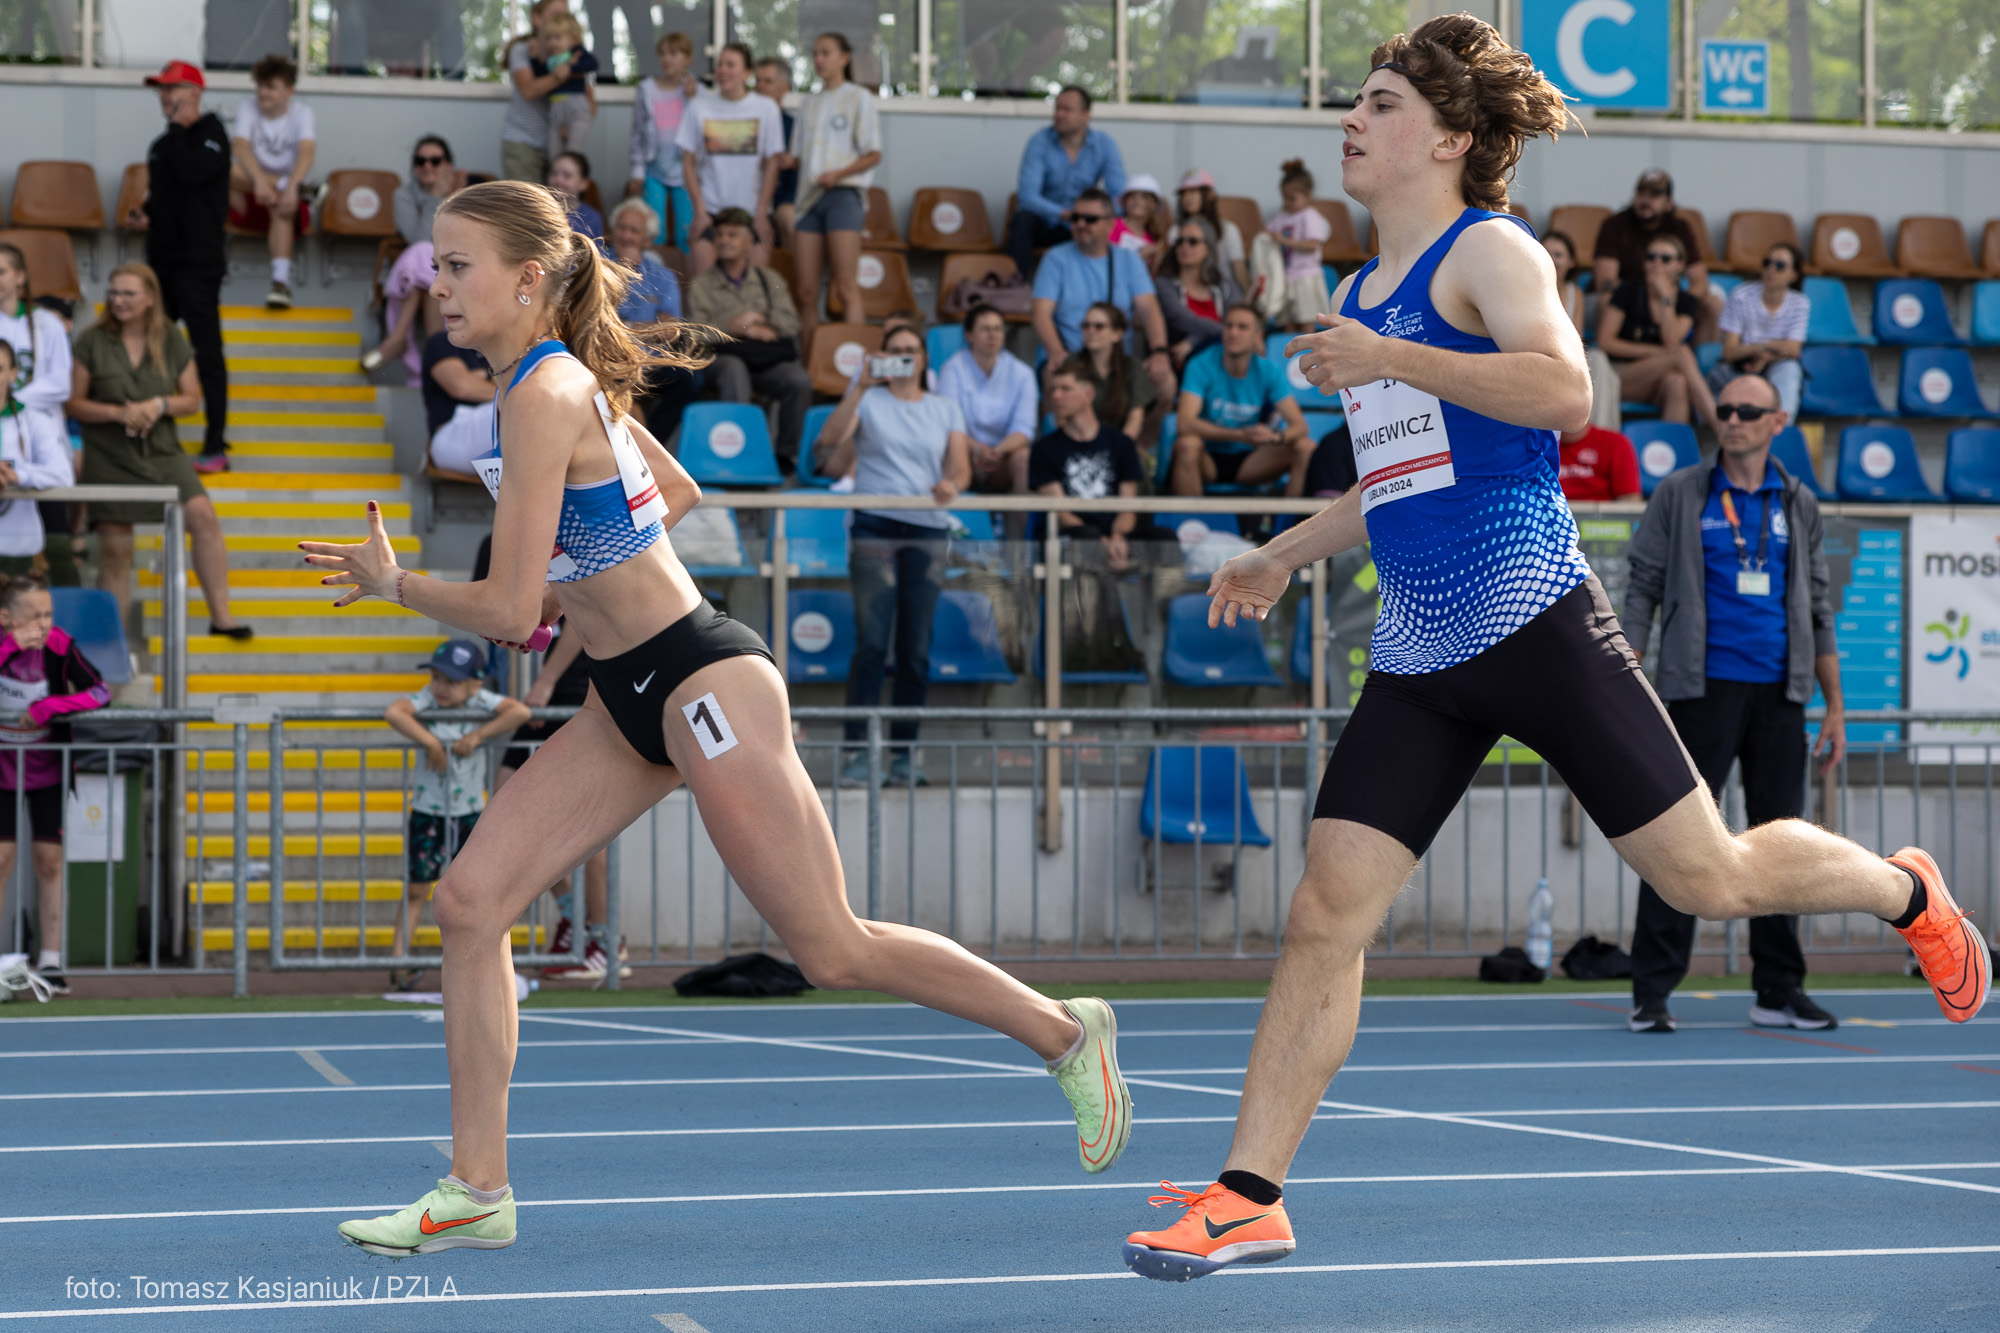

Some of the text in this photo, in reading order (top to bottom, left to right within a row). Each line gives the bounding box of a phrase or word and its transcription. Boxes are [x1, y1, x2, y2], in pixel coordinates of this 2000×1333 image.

[1556, 0, 1637, 97] C
[1707, 49, 1764, 84] WC
[1388, 324, 1425, 338] GOŁĘKA
[1403, 317, 1423, 328] START
[1348, 401, 1361, 416] LEN
[1354, 413, 1434, 457] ONKIEWICZ
[1413, 455, 1448, 469] MIESZANYCH
[1389, 478, 1413, 494] 2024
[1925, 553, 2000, 577] mos
[692, 701, 724, 744] 1
